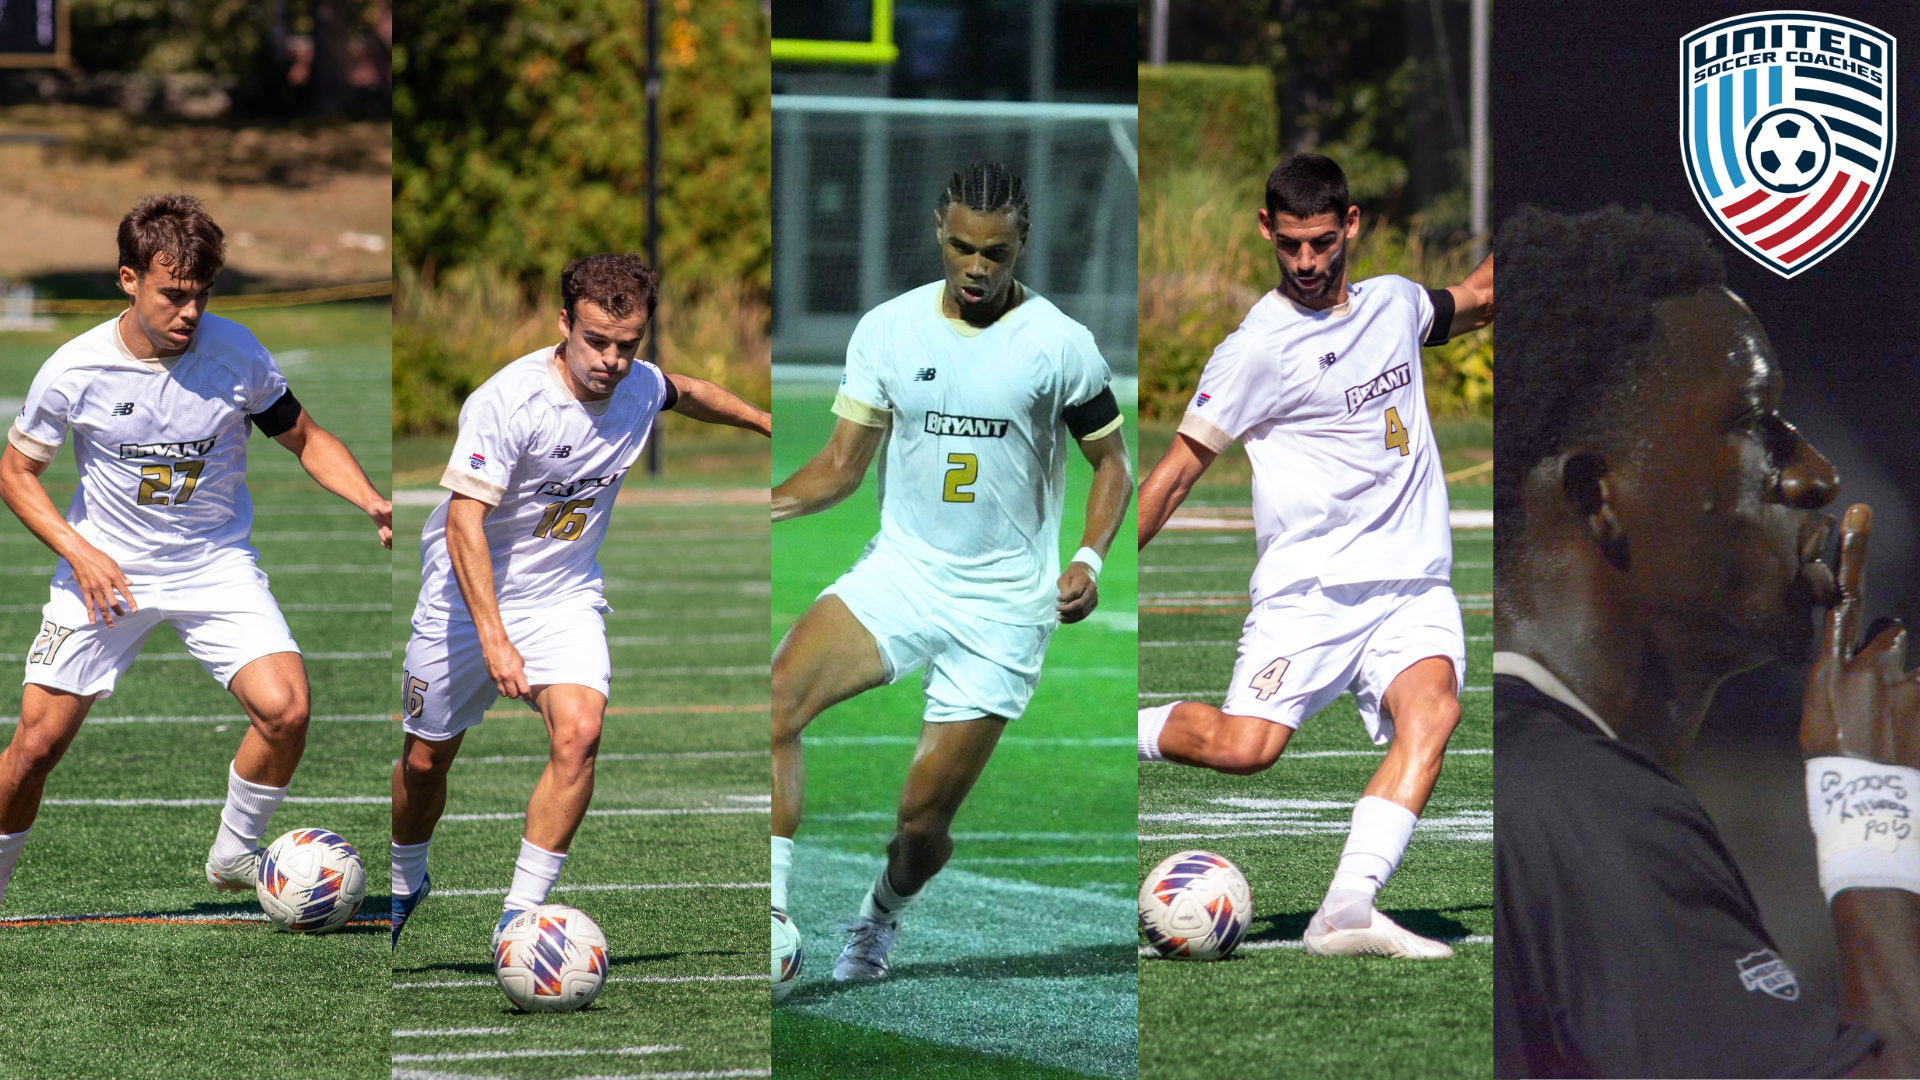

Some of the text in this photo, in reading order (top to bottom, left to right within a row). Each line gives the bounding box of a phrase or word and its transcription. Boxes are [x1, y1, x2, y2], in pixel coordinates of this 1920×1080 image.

[1344, 361, 1411, 414] BRYANT
[120, 434, 218, 460] BRYANT
[925, 411, 1010, 438] BRYANT
[1384, 406, 1410, 457] 4
[137, 460, 205, 506] 27
[942, 452, 979, 503] 2
[532, 498, 595, 541] 16
[30, 620, 75, 665] 27
[1249, 657, 1291, 701] 4
